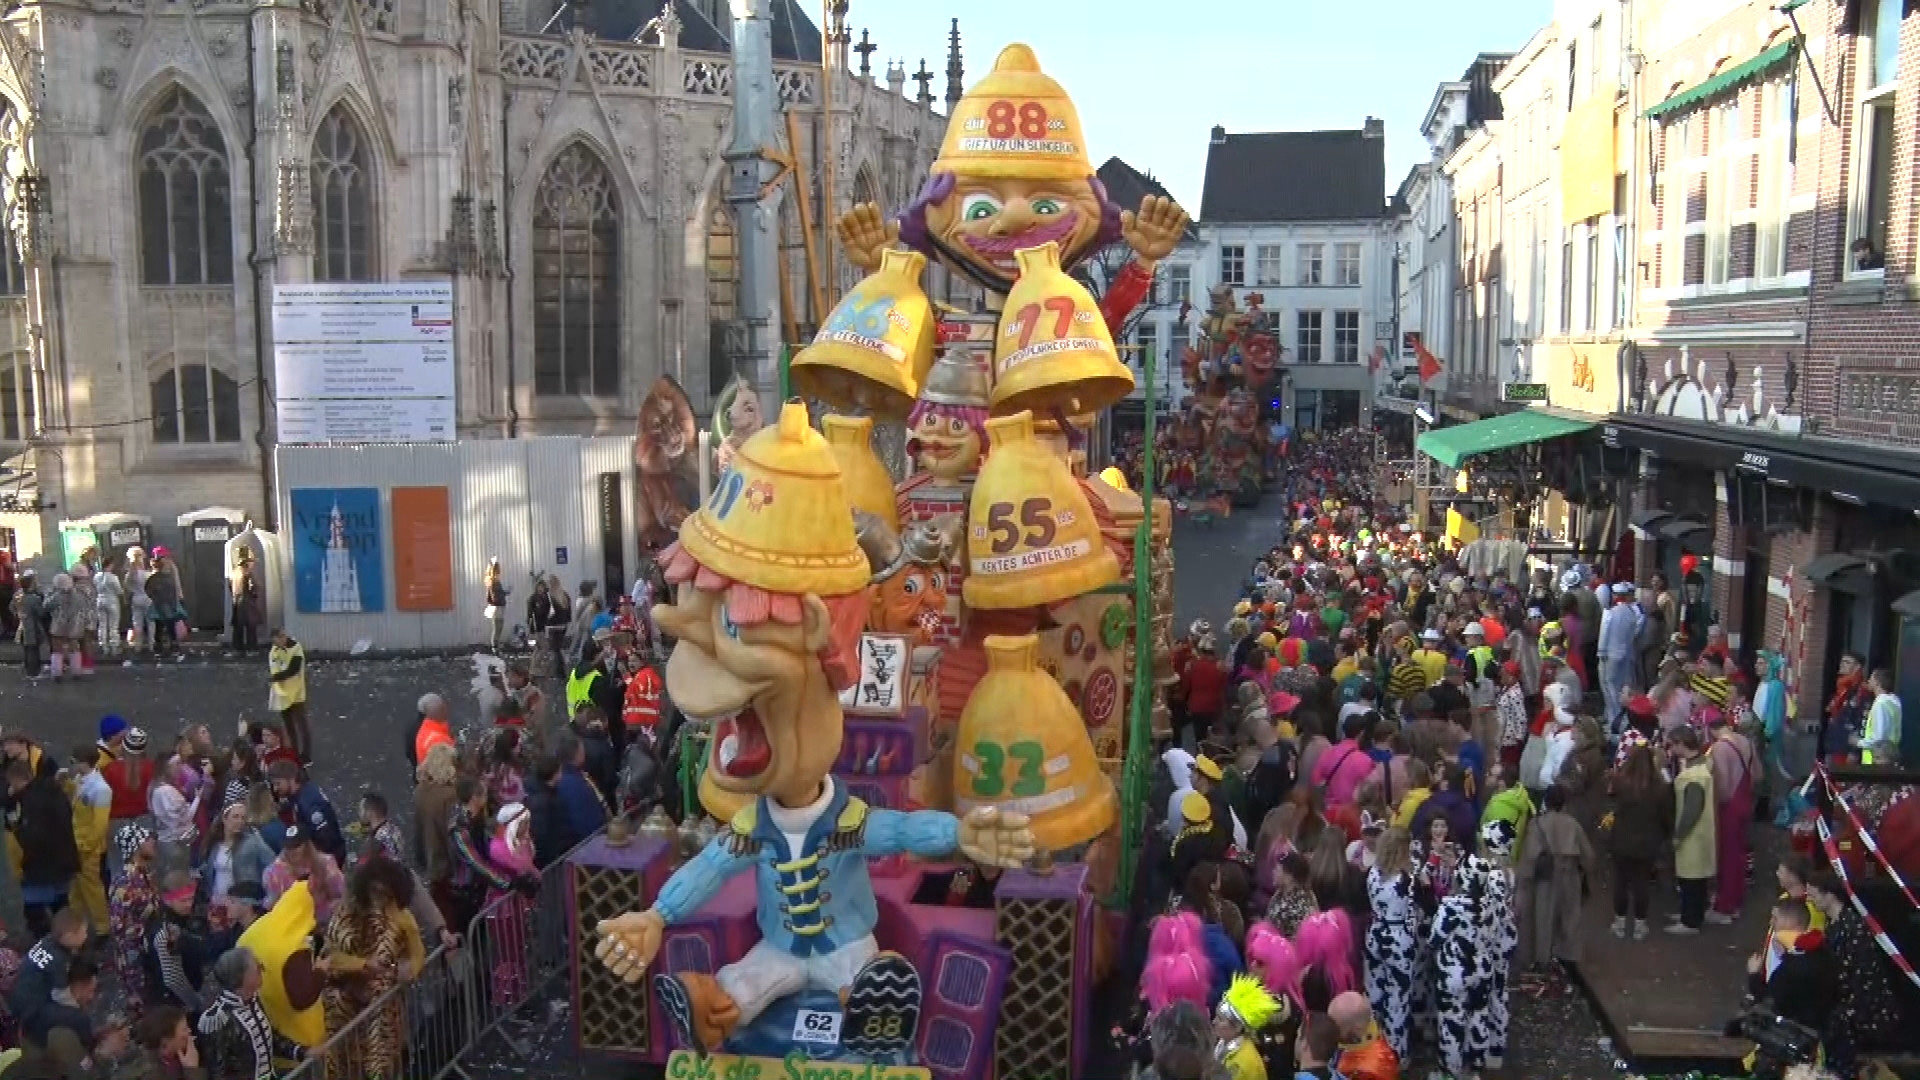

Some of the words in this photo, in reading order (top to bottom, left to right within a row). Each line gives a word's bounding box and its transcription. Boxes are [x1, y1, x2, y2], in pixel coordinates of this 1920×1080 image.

[987, 101, 1047, 139] 88
[1016, 296, 1075, 350] 77
[988, 498, 1056, 553] 55
[804, 1013, 833, 1032] 62
[864, 1016, 903, 1036] 88
